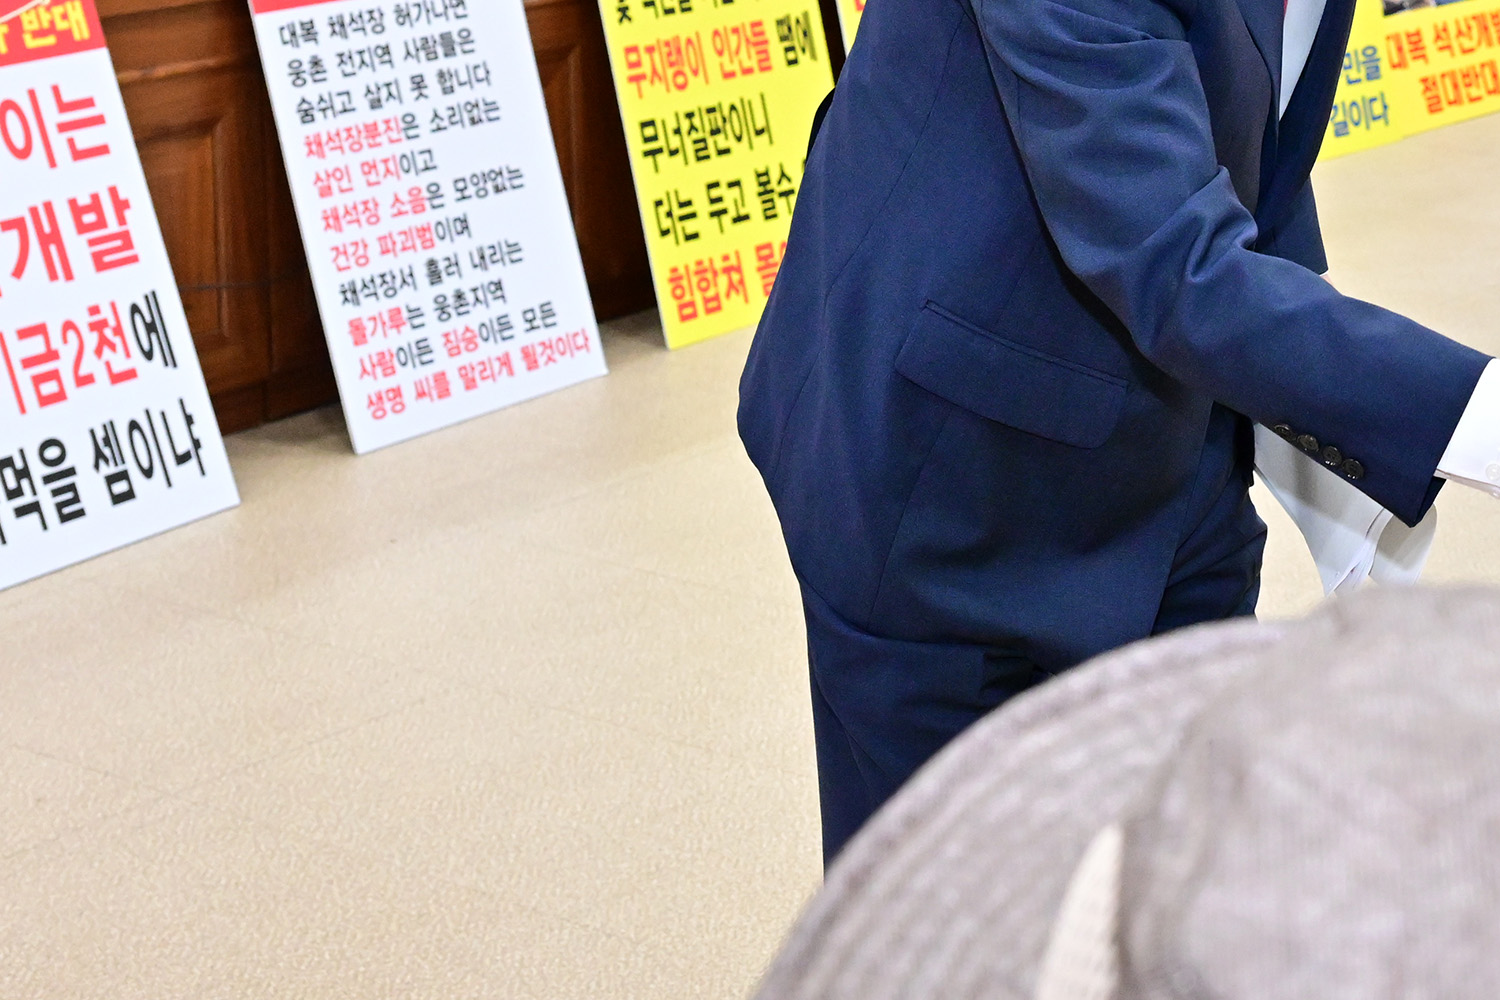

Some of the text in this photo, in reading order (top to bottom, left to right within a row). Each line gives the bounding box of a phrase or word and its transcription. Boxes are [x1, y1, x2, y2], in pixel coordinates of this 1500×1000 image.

[279, 18, 319, 48] 대복
[327, 7, 385, 40] 채석장
[286, 27, 476, 88] 웅촌 전지역 사람들은
[624, 11, 817, 100] 무지랭이 인간들 땜에
[1386, 29, 1429, 69] 대복
[0, 84, 111, 168] 이는
[296, 60, 492, 124] 숨쉬고 살지 못 합니다
[303, 97, 502, 161] 채석장분진은 소리없는
[639, 92, 773, 173] 무너질판이니
[312, 148, 438, 199] 살인 먼지이고
[321, 165, 525, 233] 채석장 소음은 모양없는
[654, 162, 795, 246] 더는 두고 볼수
[0, 185, 140, 283] 개발
[330, 213, 473, 273] 건강 파괴범이며
[338, 238, 525, 308] 채석장서 흘러 내리는
[669, 241, 787, 323] 힘합쳐 몰
[348, 278, 507, 347] 돌가루는 웅촌지역
[358, 300, 558, 382] 사람이든 짐승이든 모든
[367, 328, 591, 421] 생명 씨를 말리게 될것이다
[90, 398, 206, 506] 셈이냐
